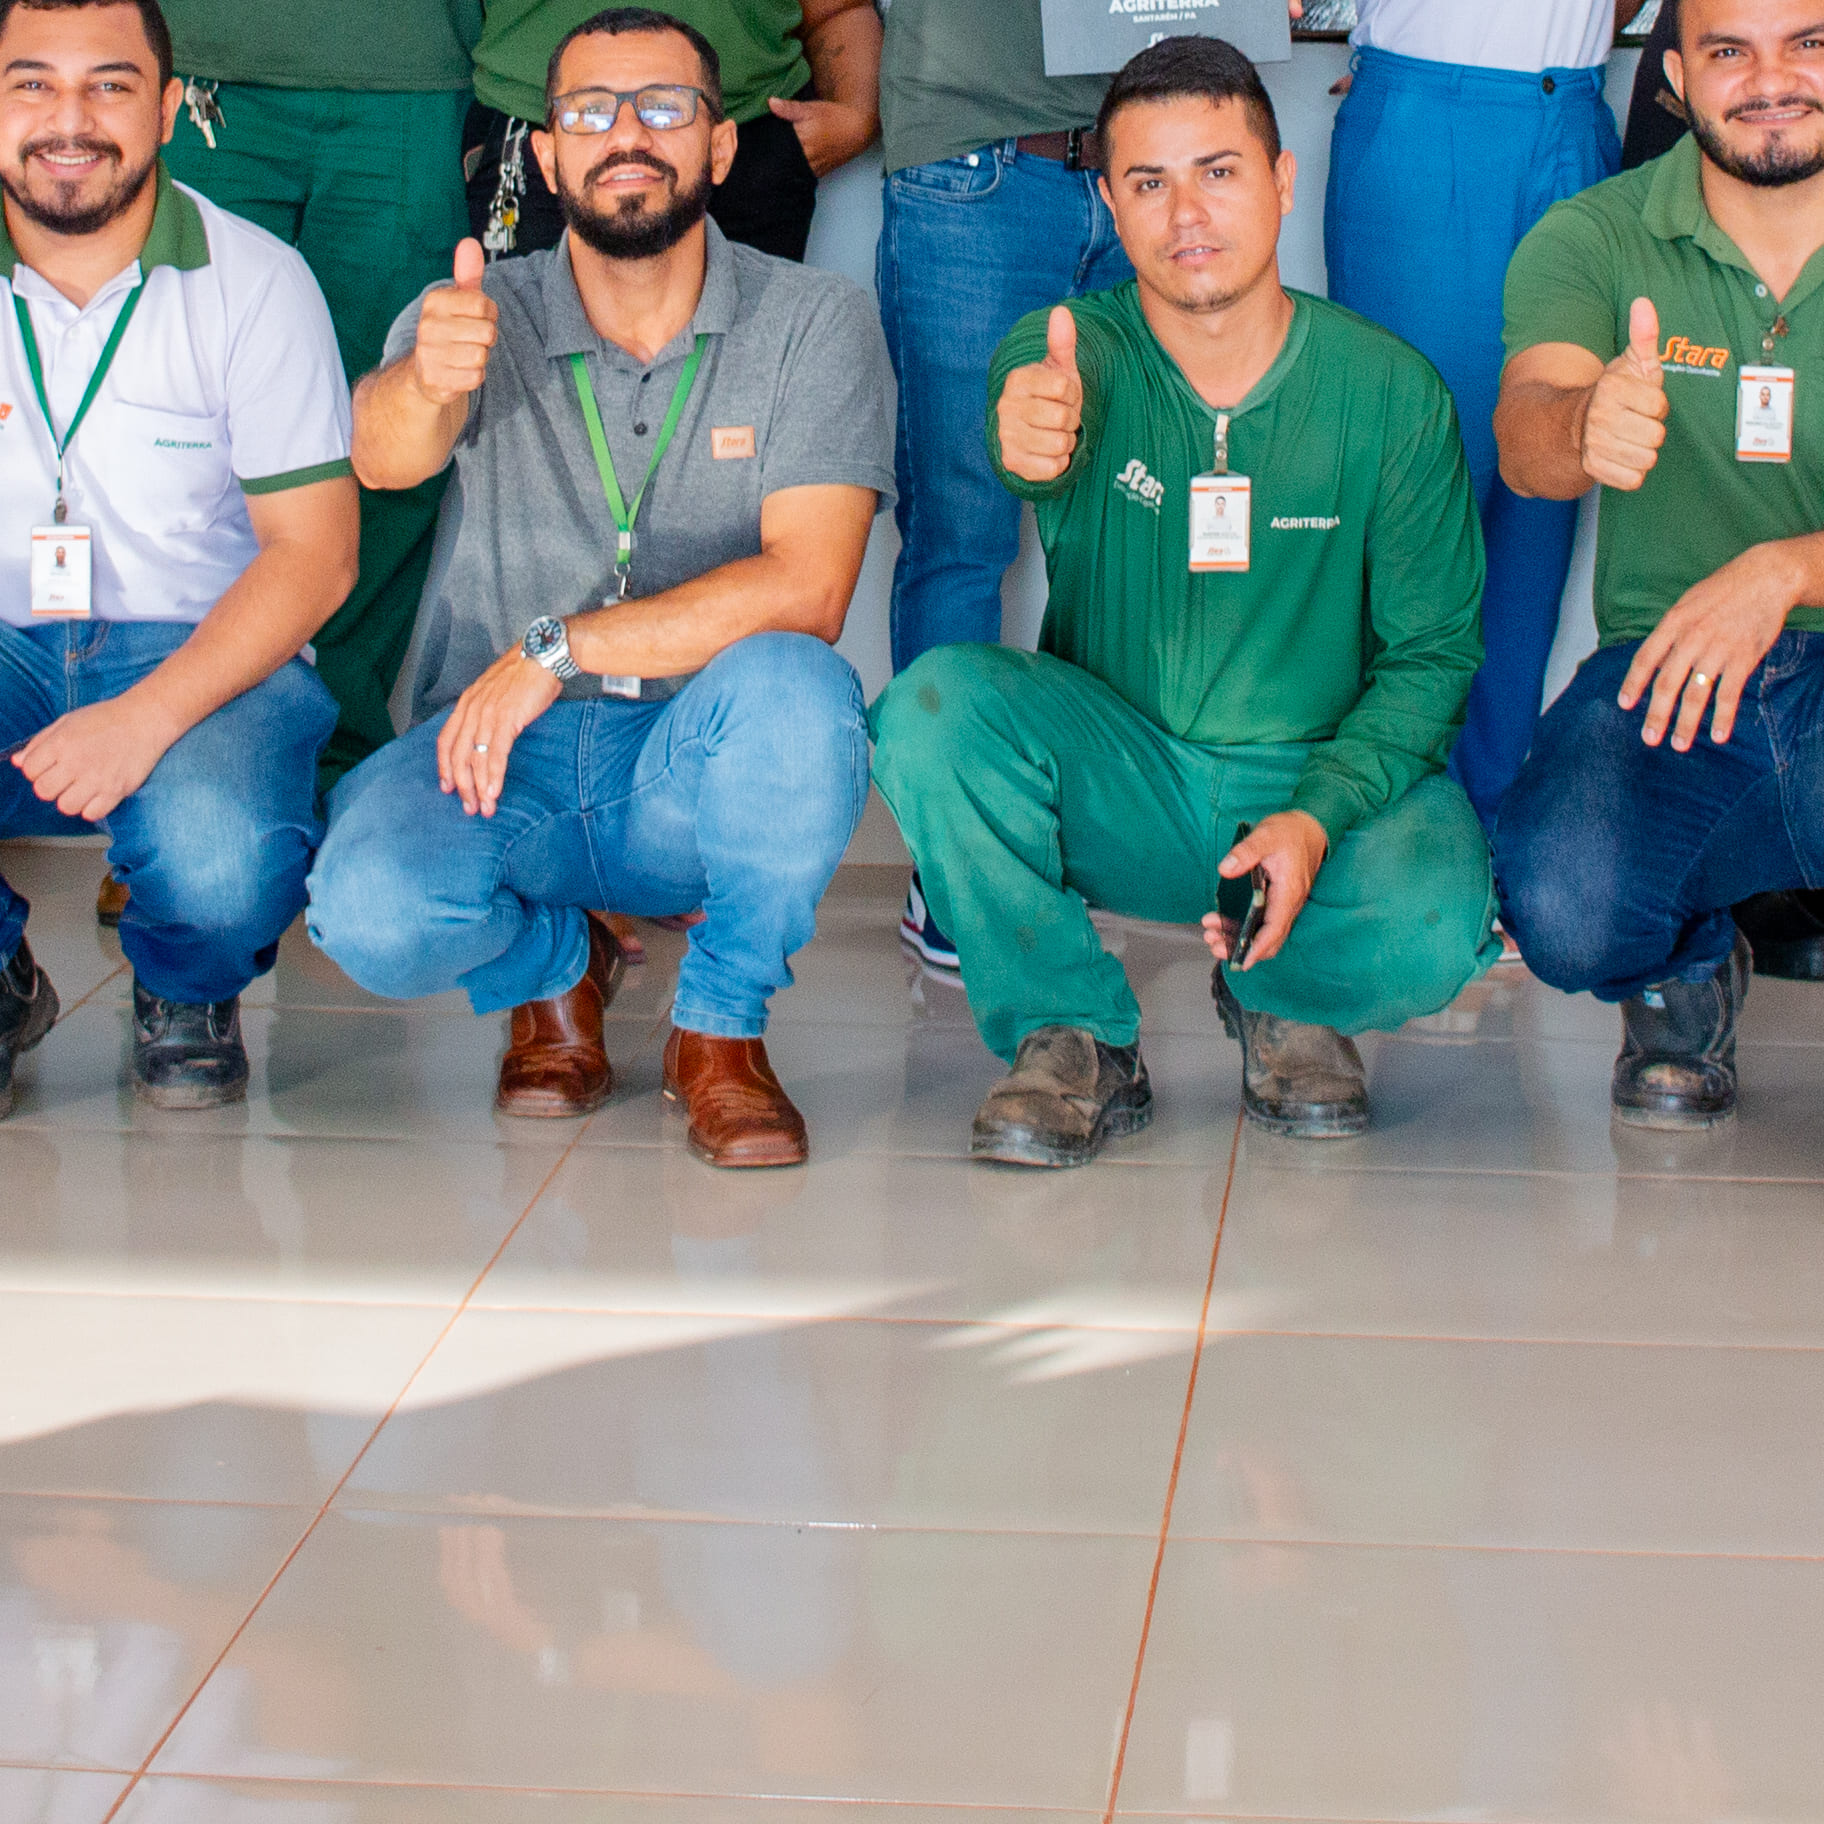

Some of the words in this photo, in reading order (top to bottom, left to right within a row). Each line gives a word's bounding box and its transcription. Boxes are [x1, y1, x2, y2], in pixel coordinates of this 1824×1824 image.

[1659, 336, 1729, 369] Stara
[154, 437, 213, 450] AGRITERRA
[1116, 458, 1165, 506] Star
